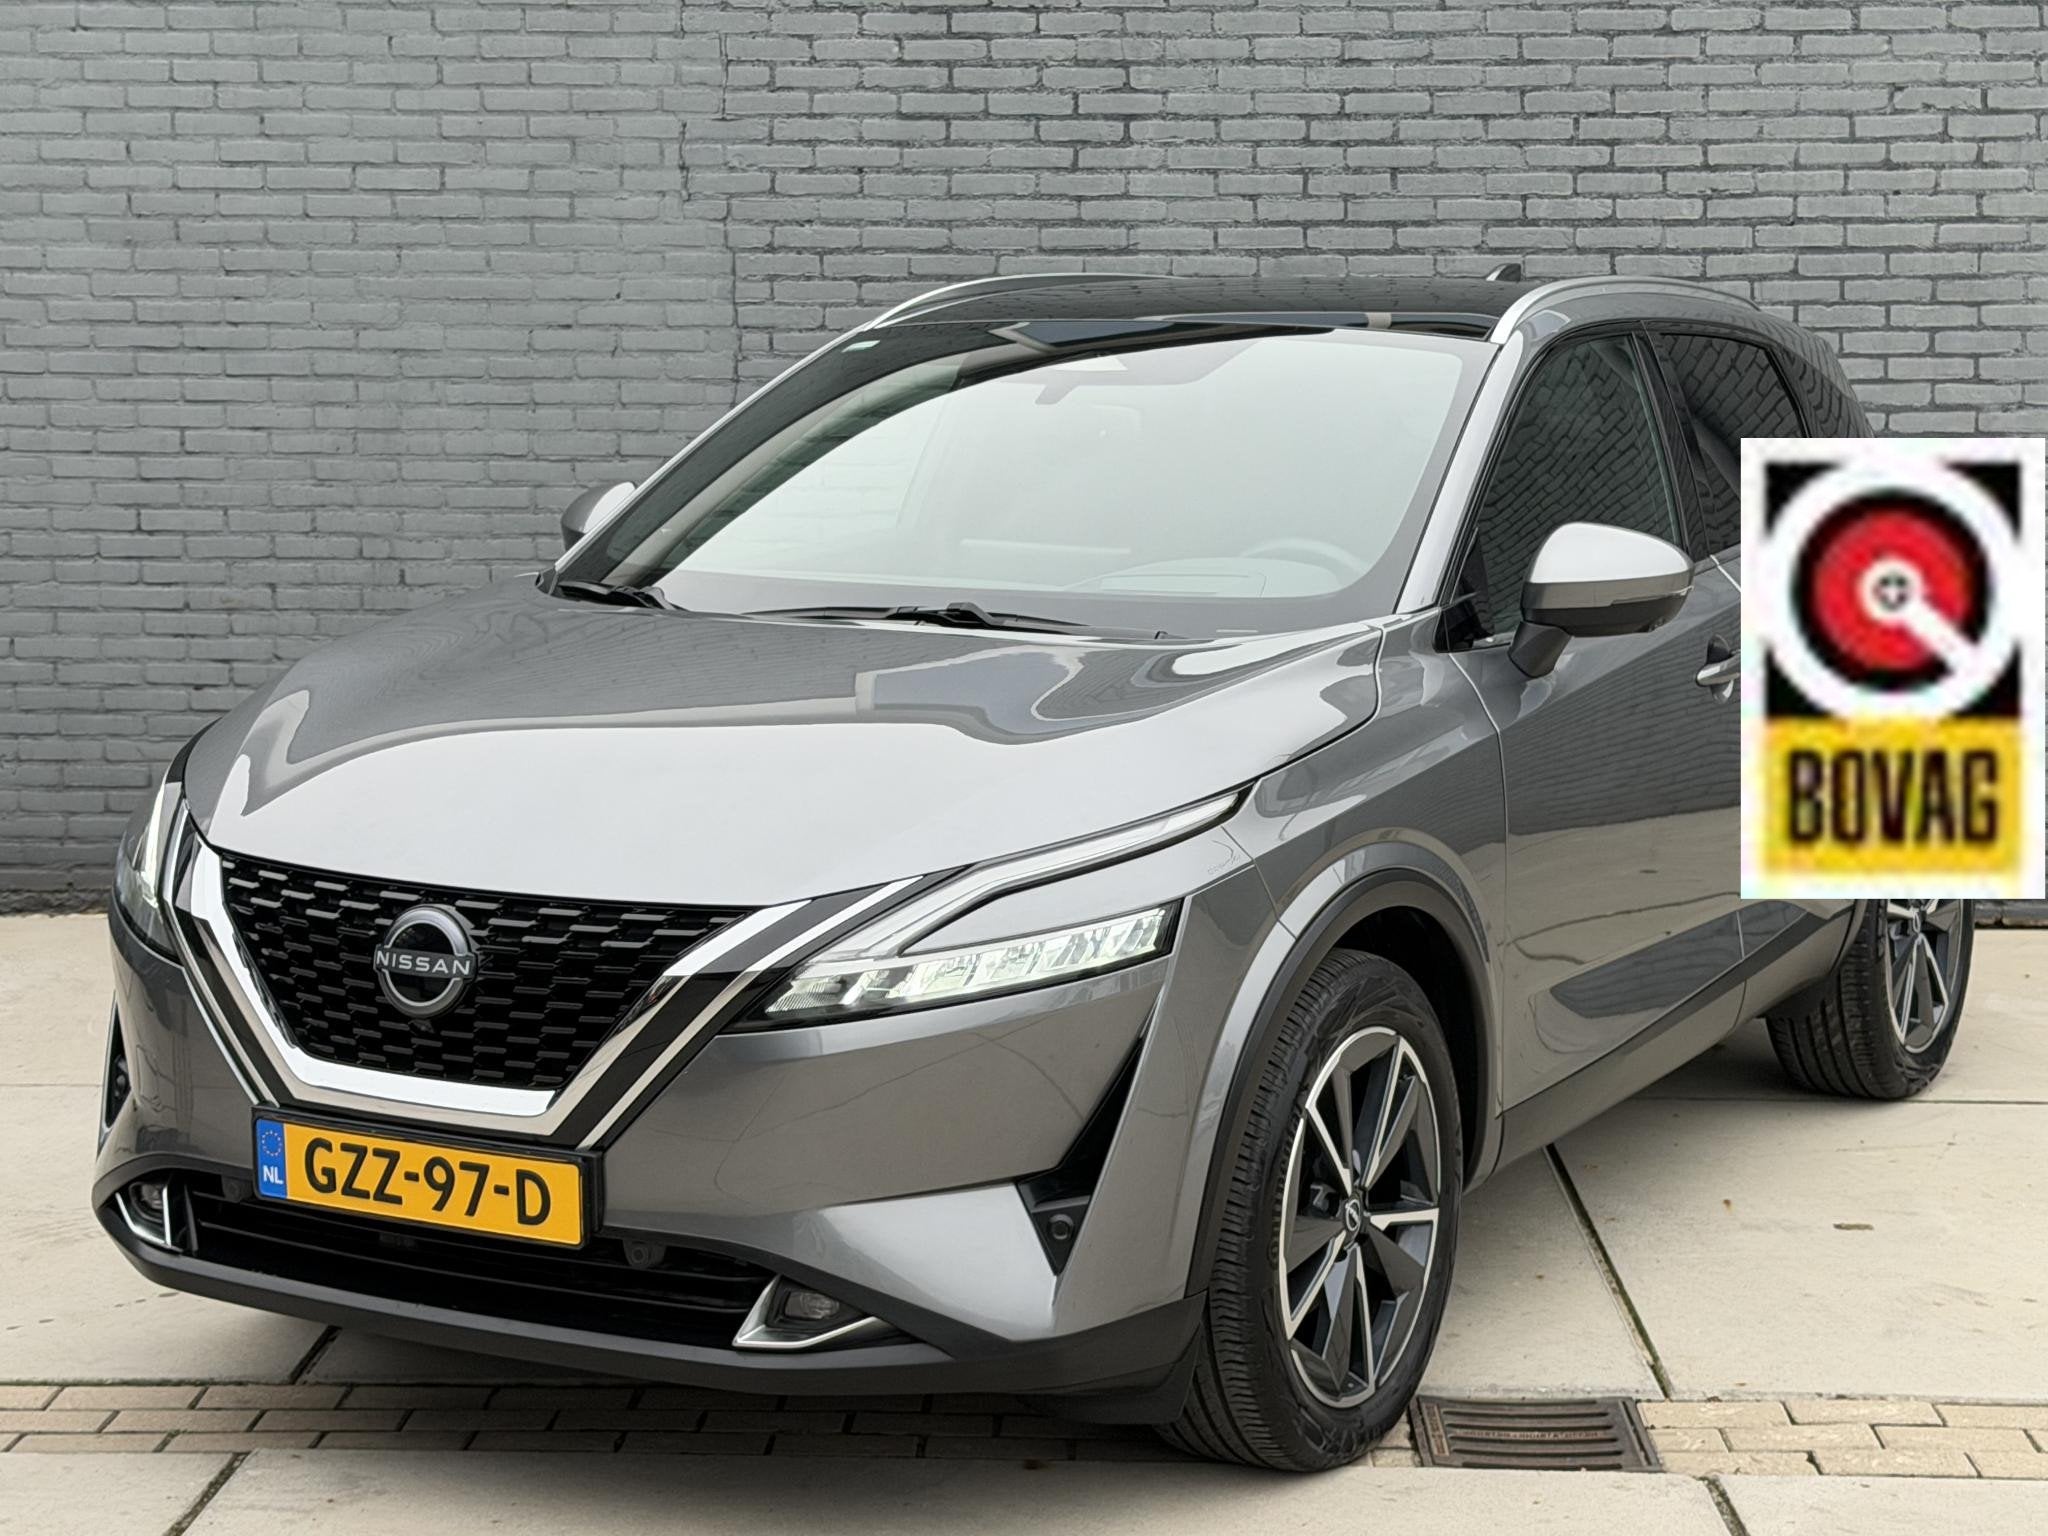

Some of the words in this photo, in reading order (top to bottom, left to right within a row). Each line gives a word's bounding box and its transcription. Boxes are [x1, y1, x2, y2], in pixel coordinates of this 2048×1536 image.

[376, 950, 471, 975] NISSAN
[263, 1165, 284, 1186] NL
[304, 1137, 551, 1226] GZZ-97-D
